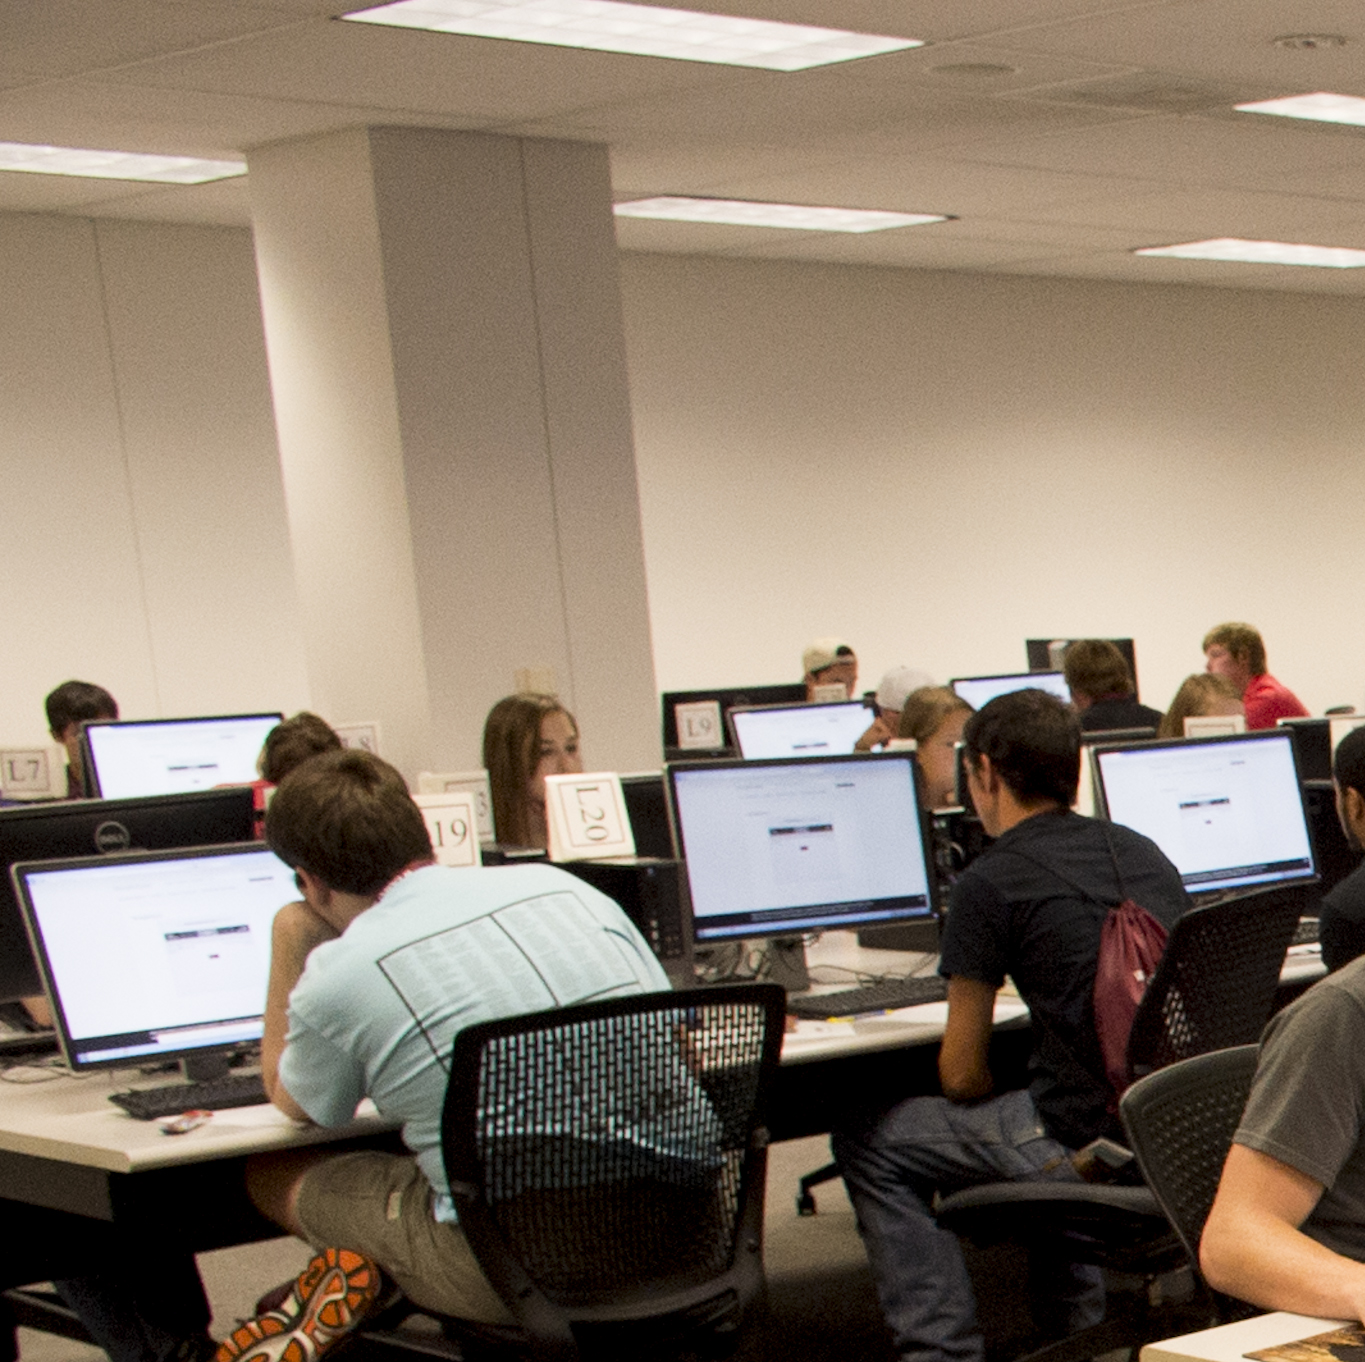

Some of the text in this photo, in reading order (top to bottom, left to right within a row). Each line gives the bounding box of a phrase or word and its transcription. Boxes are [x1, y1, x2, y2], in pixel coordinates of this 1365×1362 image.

[686, 716, 712, 738] L9
[8, 759, 39, 782] L7
[575, 785, 610, 842] L20
[434, 818, 468, 848] 19
